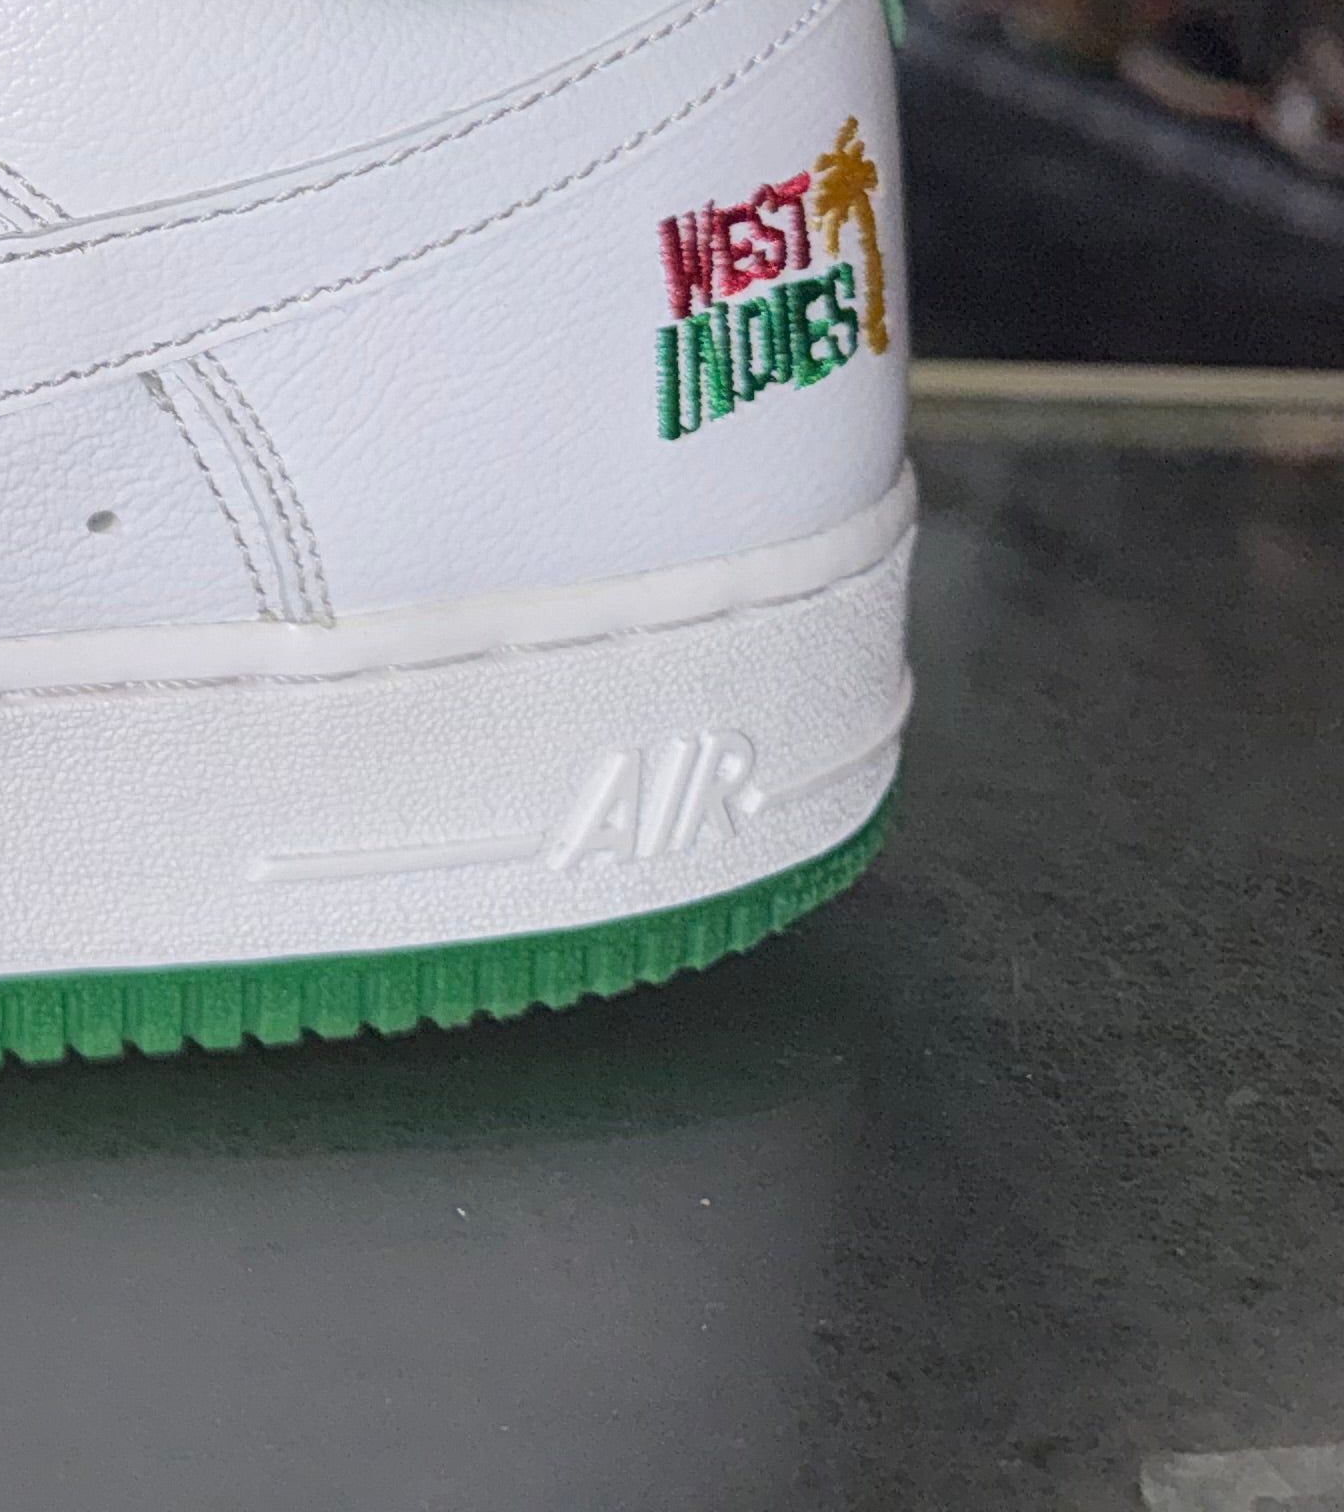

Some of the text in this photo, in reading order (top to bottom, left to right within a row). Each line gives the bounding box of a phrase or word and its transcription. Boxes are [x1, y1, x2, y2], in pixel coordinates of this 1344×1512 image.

[657, 170, 812, 319] WEST
[655, 262, 859, 441] INDIES
[545, 728, 756, 872] AIR
